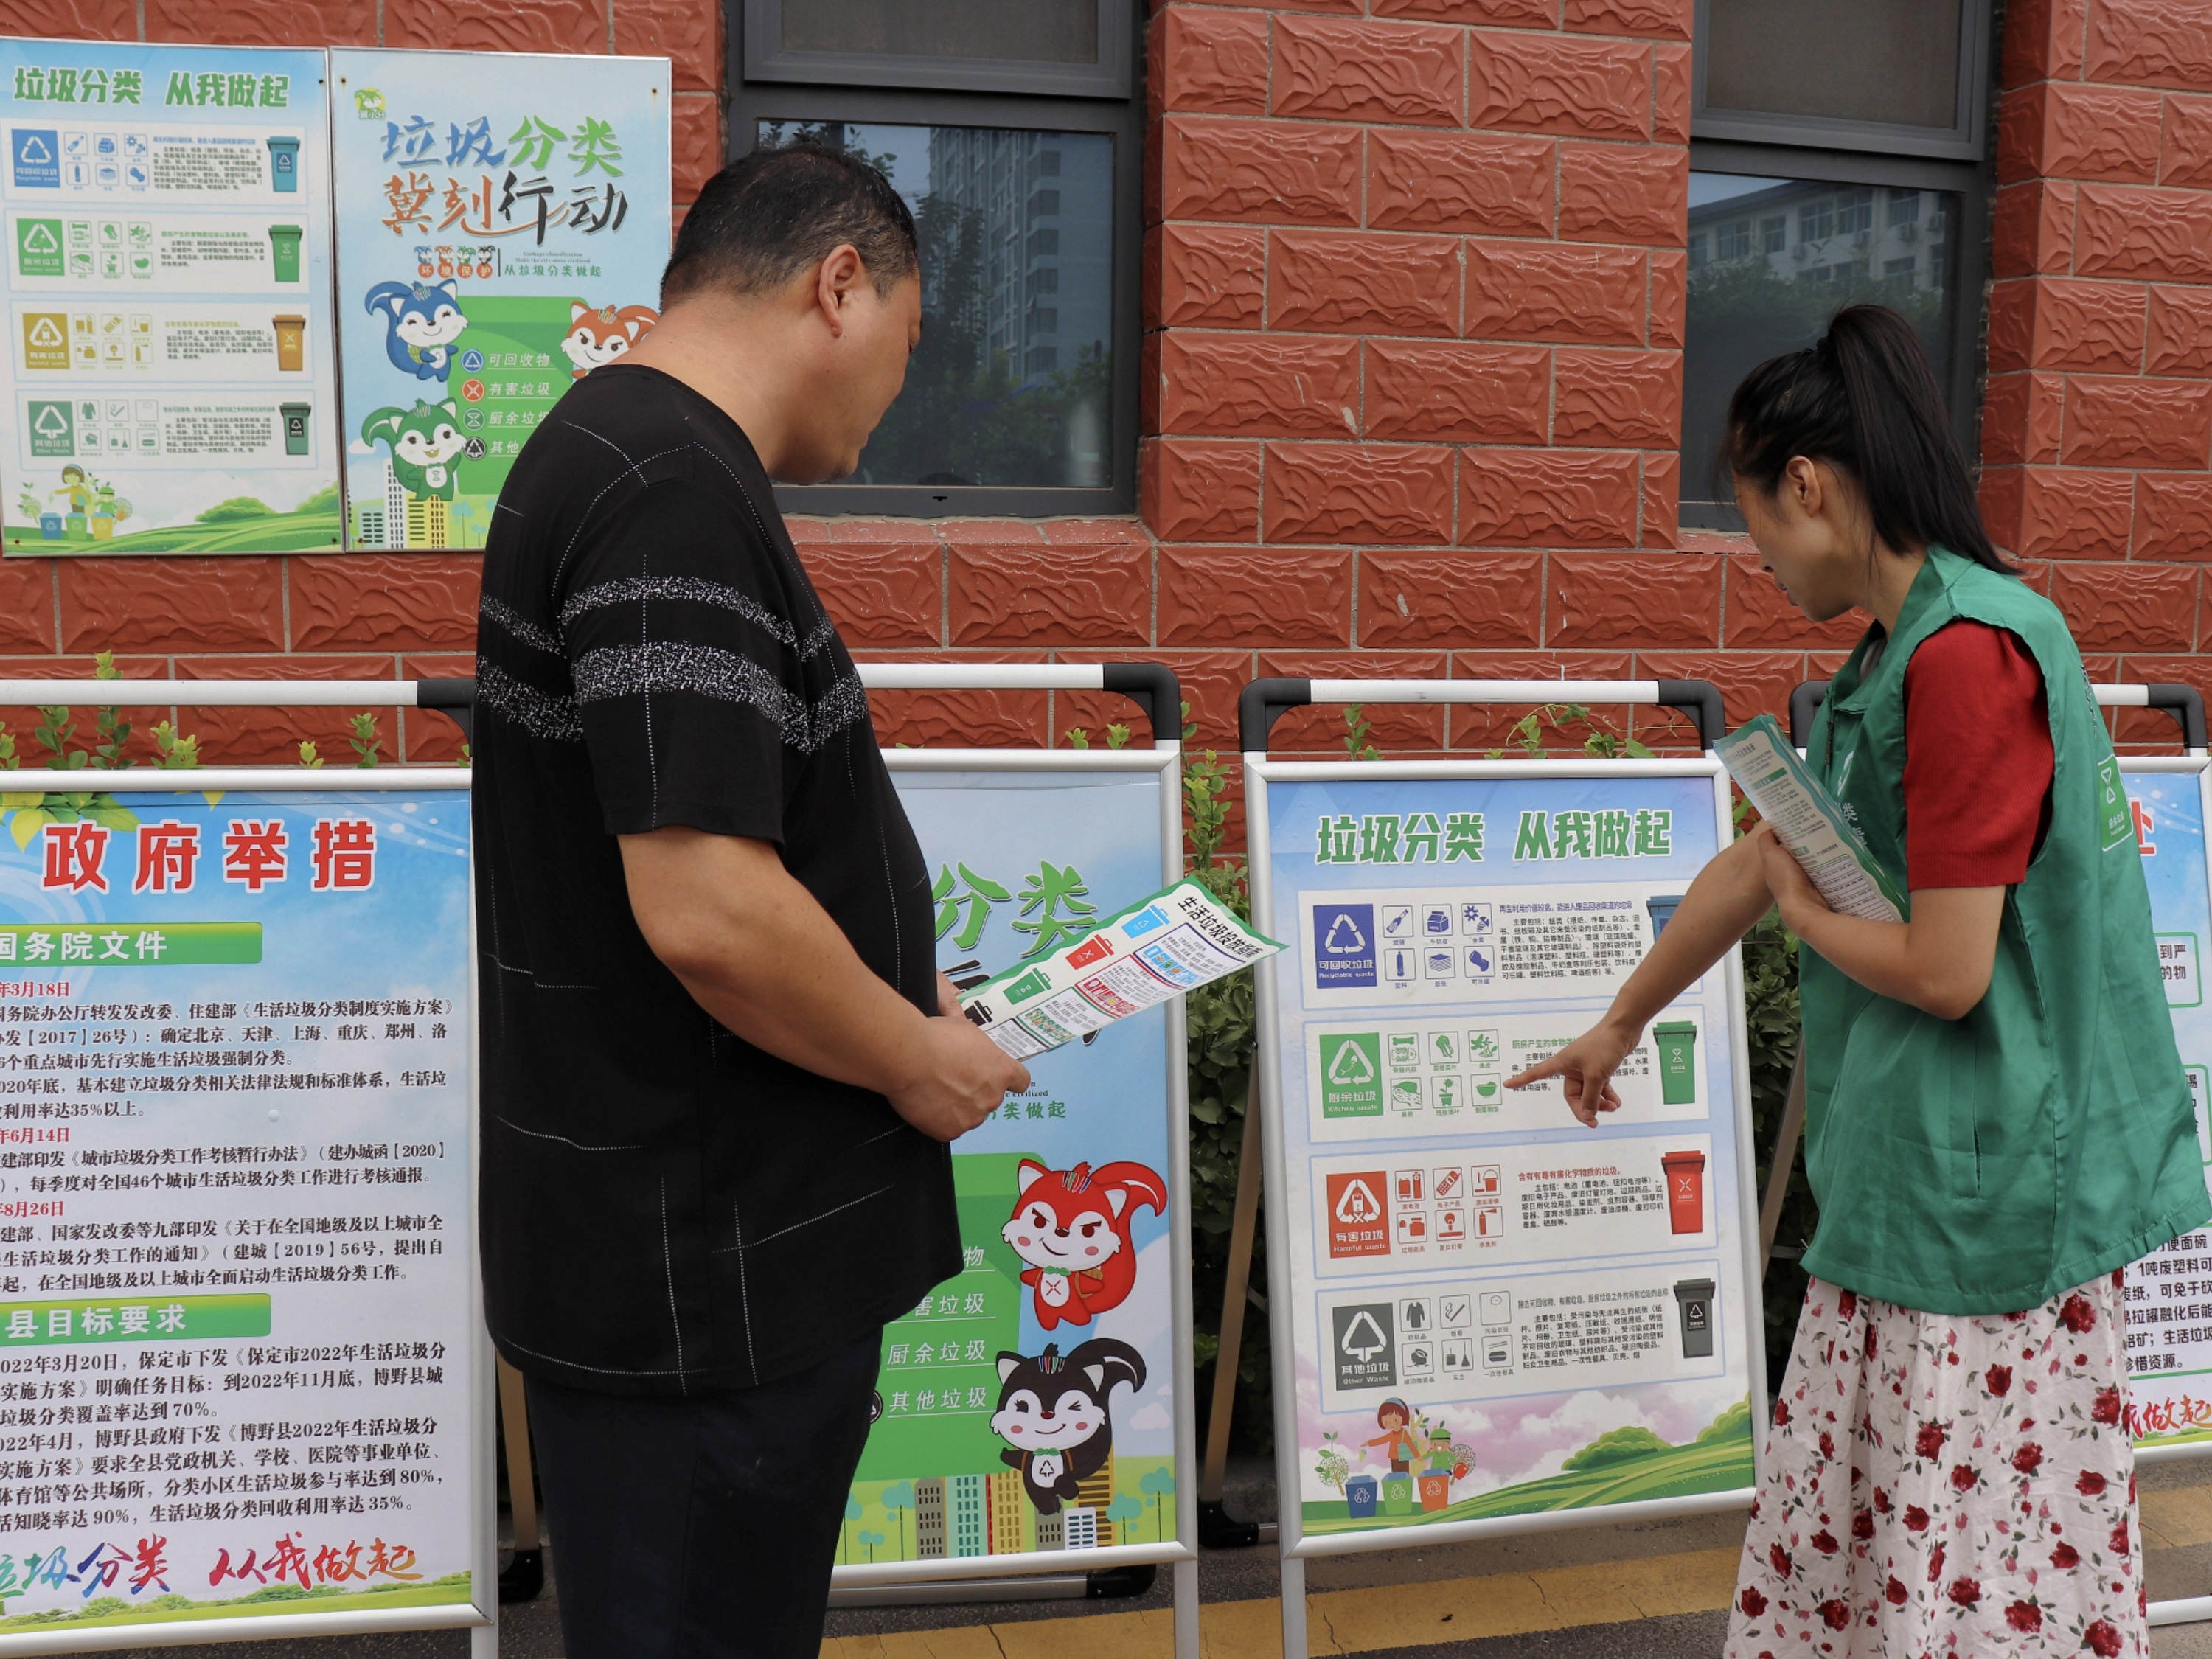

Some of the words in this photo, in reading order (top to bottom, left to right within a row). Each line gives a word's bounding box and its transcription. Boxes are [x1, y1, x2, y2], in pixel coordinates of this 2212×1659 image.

[13, 67, 142, 105] 垃圾分类
[164, 71, 289, 108] 从我做起
[380, 114, 624, 177] 垃圾分类
[381, 170, 628, 246] 冀刻行动
[504, 264, 601, 277] 从垃圾分类做起
[489, 353, 550, 366] 可回收物
[489, 382, 550, 396] 有害垃圾
[1317, 813, 1484, 863] 垃圾分类
[1514, 810, 1672, 860] 从我做起
[43, 821, 375, 891] 政府举措
[1319, 960, 1373, 970] 可回收垃圾
[0, 999, 453, 1022] 务院办公厅转发发改委、住建部《生活垃圾分类制度实施方案》
[1512, 1037, 1578, 1049] 厨房产生的食物类
[1329, 1091, 1377, 1103] 厨余垃圾
[0, 1101, 145, 1120] 利用率达35%以上。
[1518, 1166, 1621, 1181] 含有有毒有害化学物质的垃圾。
[1335, 1229, 1383, 1242] 有害垃圾
[0, 1265, 407, 1293] 起，在全国地级及以上城市全面启动生活垃圾分类工作。
[4, 1304, 187, 1339] 县目标要求
[887, 1340, 986, 1366] 厨余垃圾
[1341, 1362, 1389, 1375] 其他垃圾
[1343, 1377, 1363, 1385] Other
[889, 1387, 987, 1413] 其他垃圾
[209, 1532, 425, 1590] 从我做起
